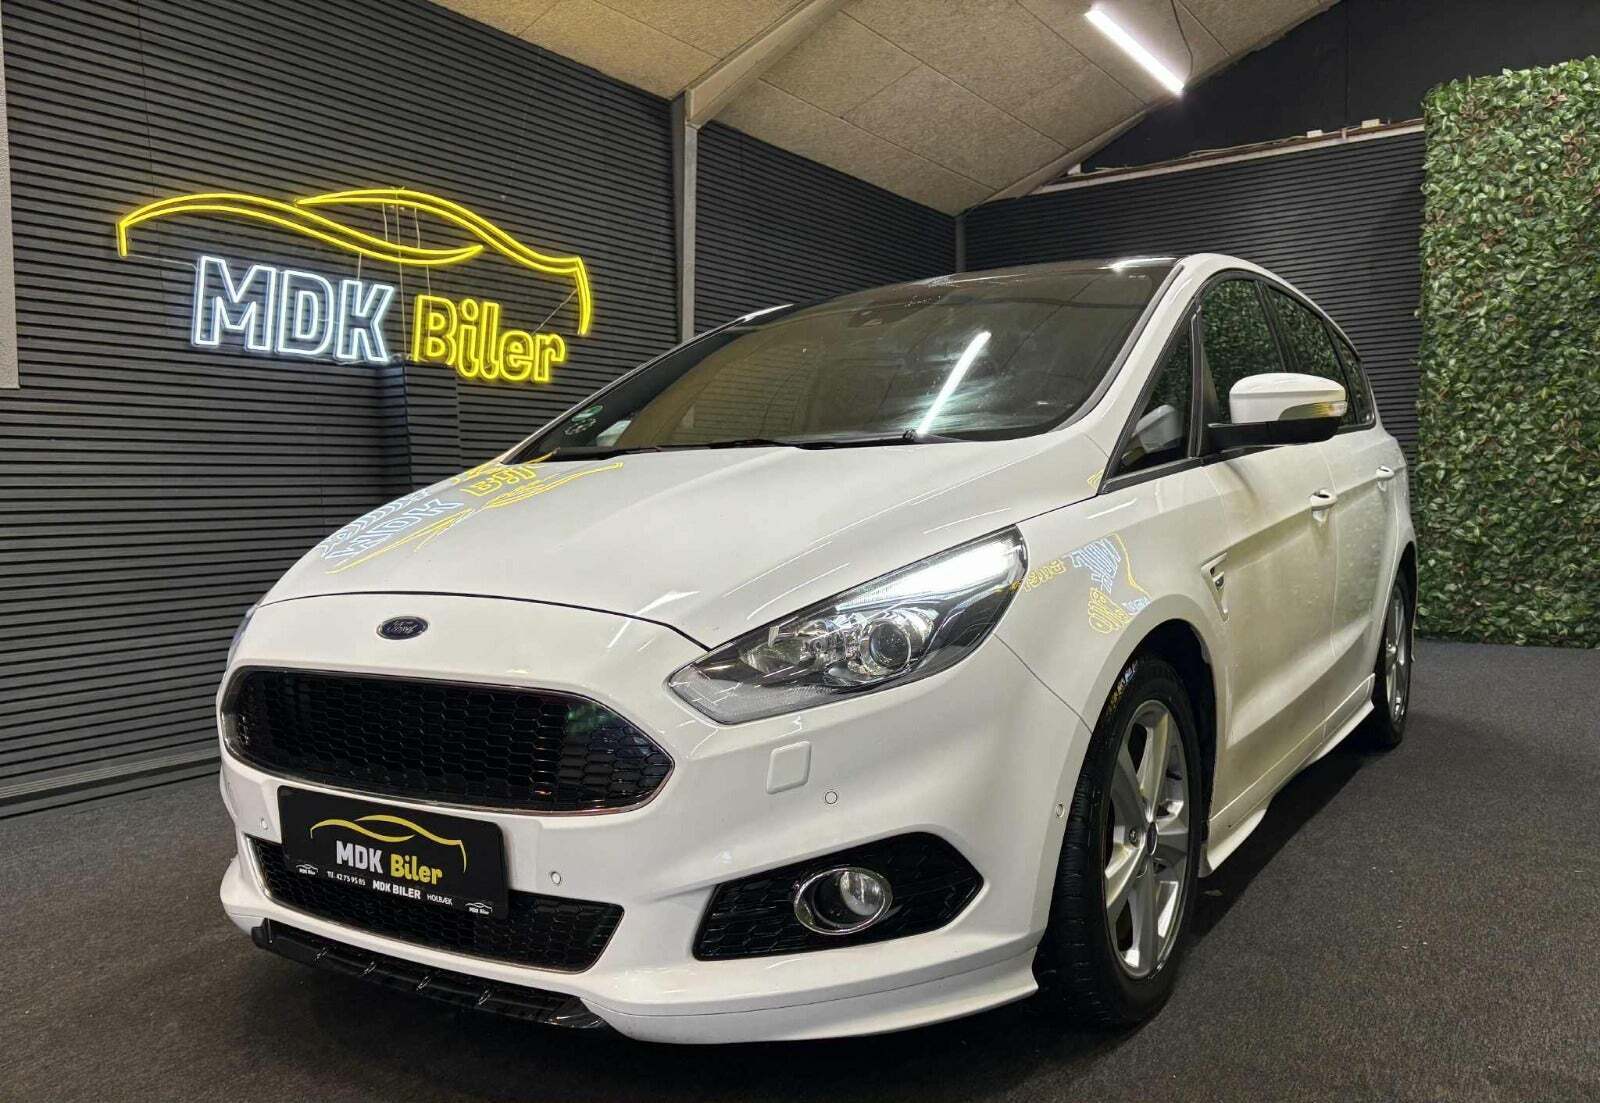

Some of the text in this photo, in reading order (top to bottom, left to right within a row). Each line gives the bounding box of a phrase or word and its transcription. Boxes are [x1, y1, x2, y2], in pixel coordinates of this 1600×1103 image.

[191, 255, 567, 384] MDK Biler
[336, 840, 443, 885] MDK Biler
[372, 880, 421, 899] MDK BILER
